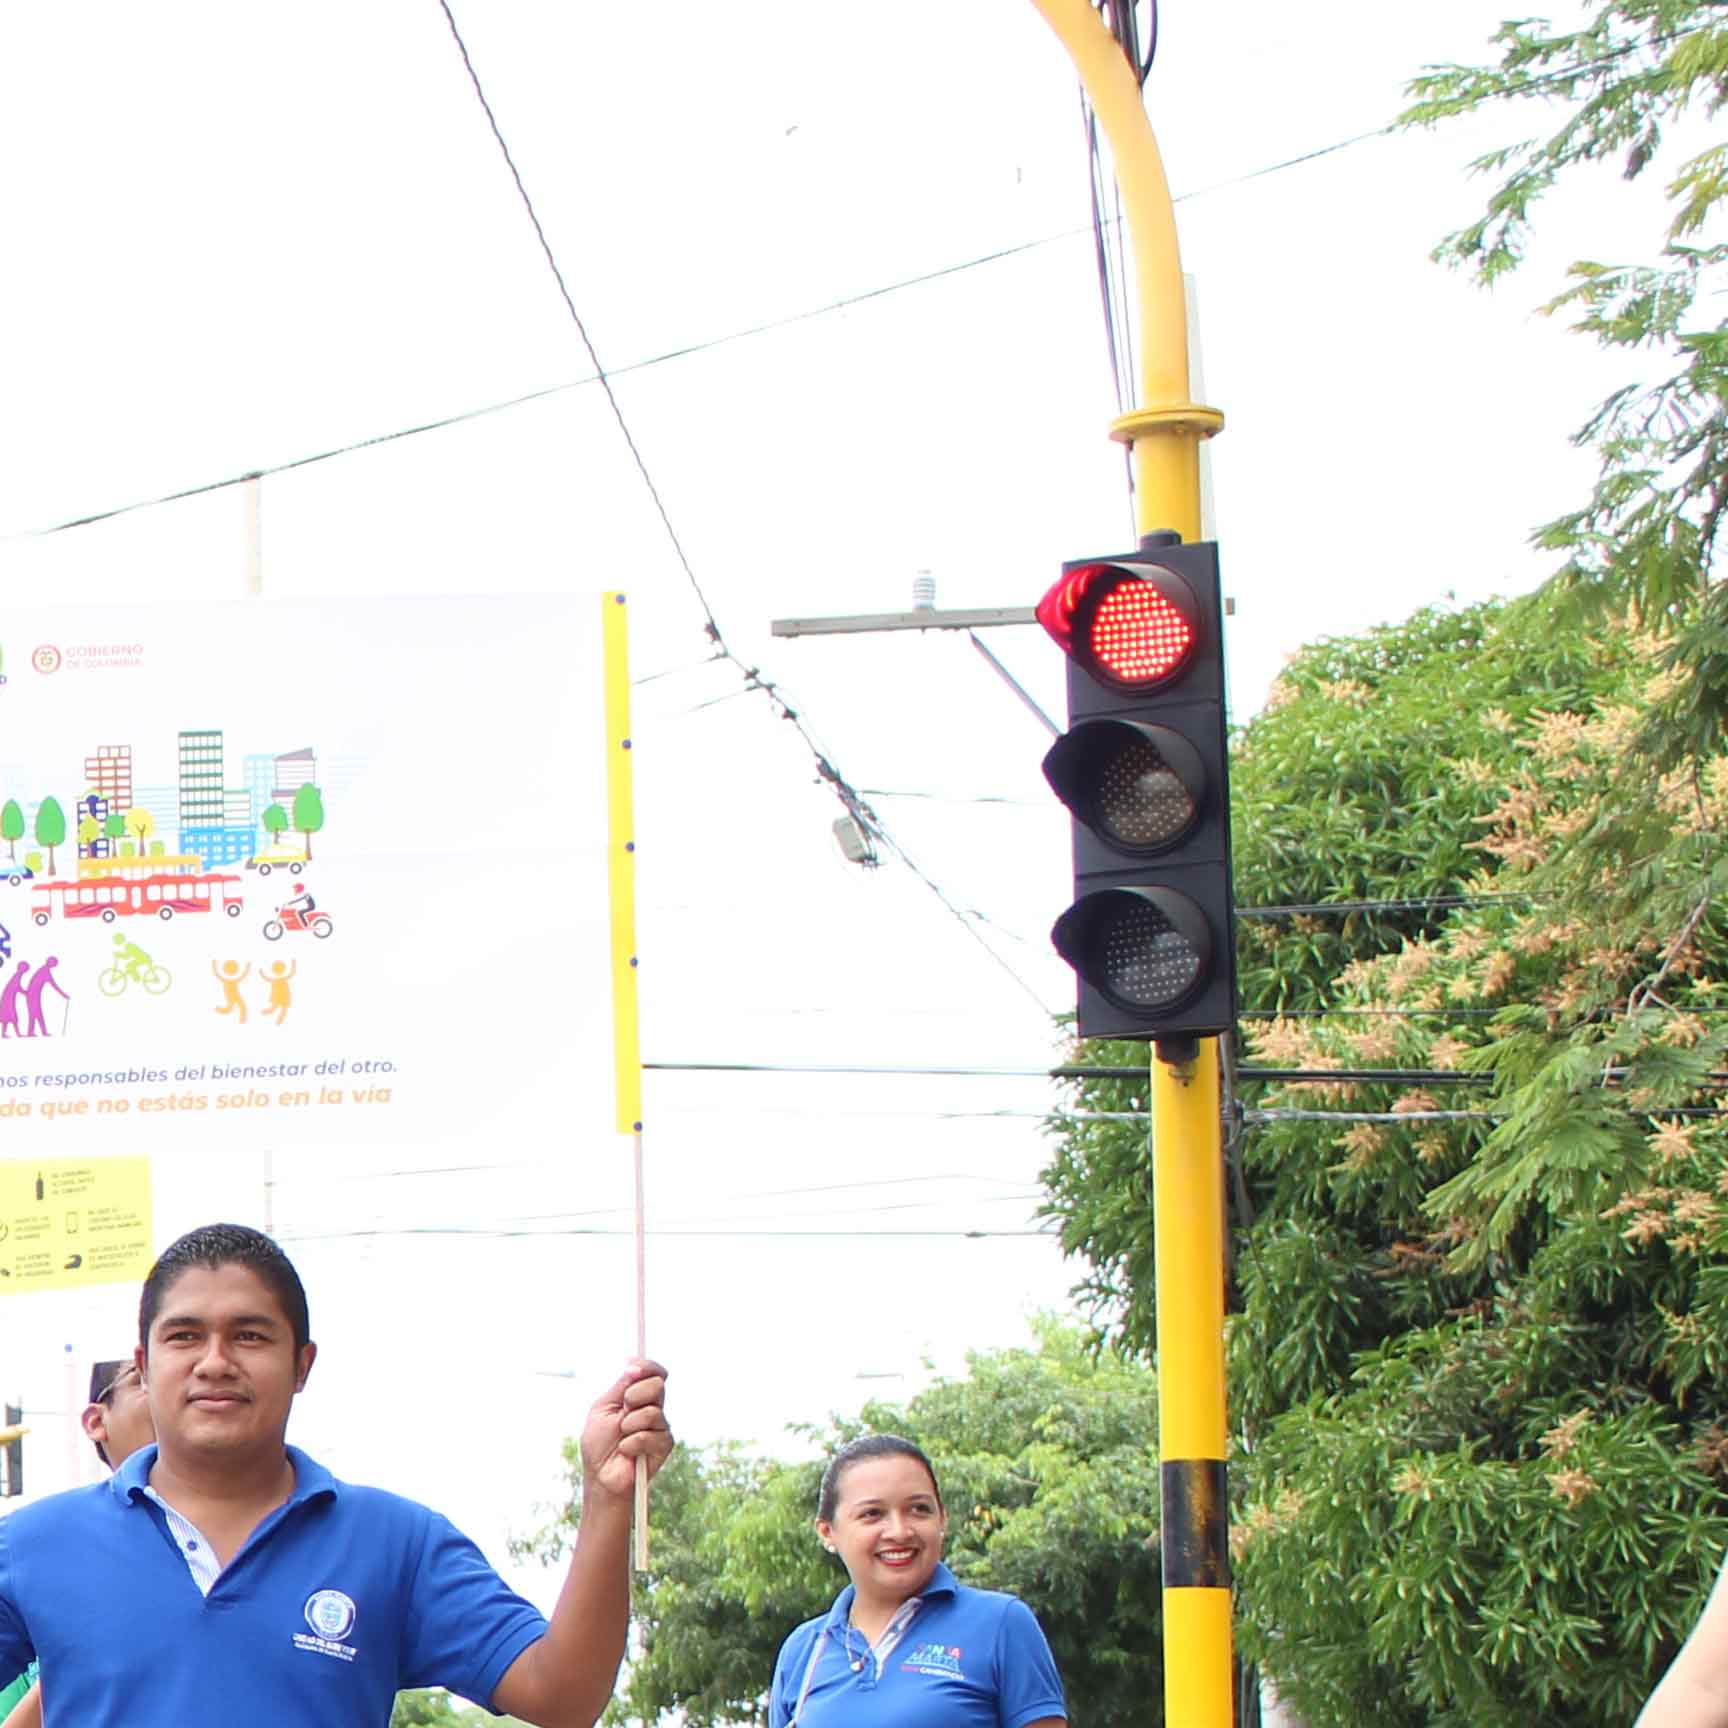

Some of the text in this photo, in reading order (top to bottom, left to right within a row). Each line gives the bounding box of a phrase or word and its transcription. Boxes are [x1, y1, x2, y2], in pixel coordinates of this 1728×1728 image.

[66, 643, 144, 658] GOBIERNO
[34, 1066, 169, 1090] responsables
[174, 1064, 206, 1081] del
[211, 1059, 309, 1080] bienestar
[314, 1058, 346, 1076] del
[351, 1059, 398, 1075] otro.
[39, 1098, 89, 1120] que
[95, 1097, 131, 1114] no
[137, 1089, 208, 1112] estás
[215, 1088, 271, 1109] solo
[278, 1090, 311, 1107] en
[317, 1084, 344, 1104] la
[351, 1082, 392, 1104] vía
